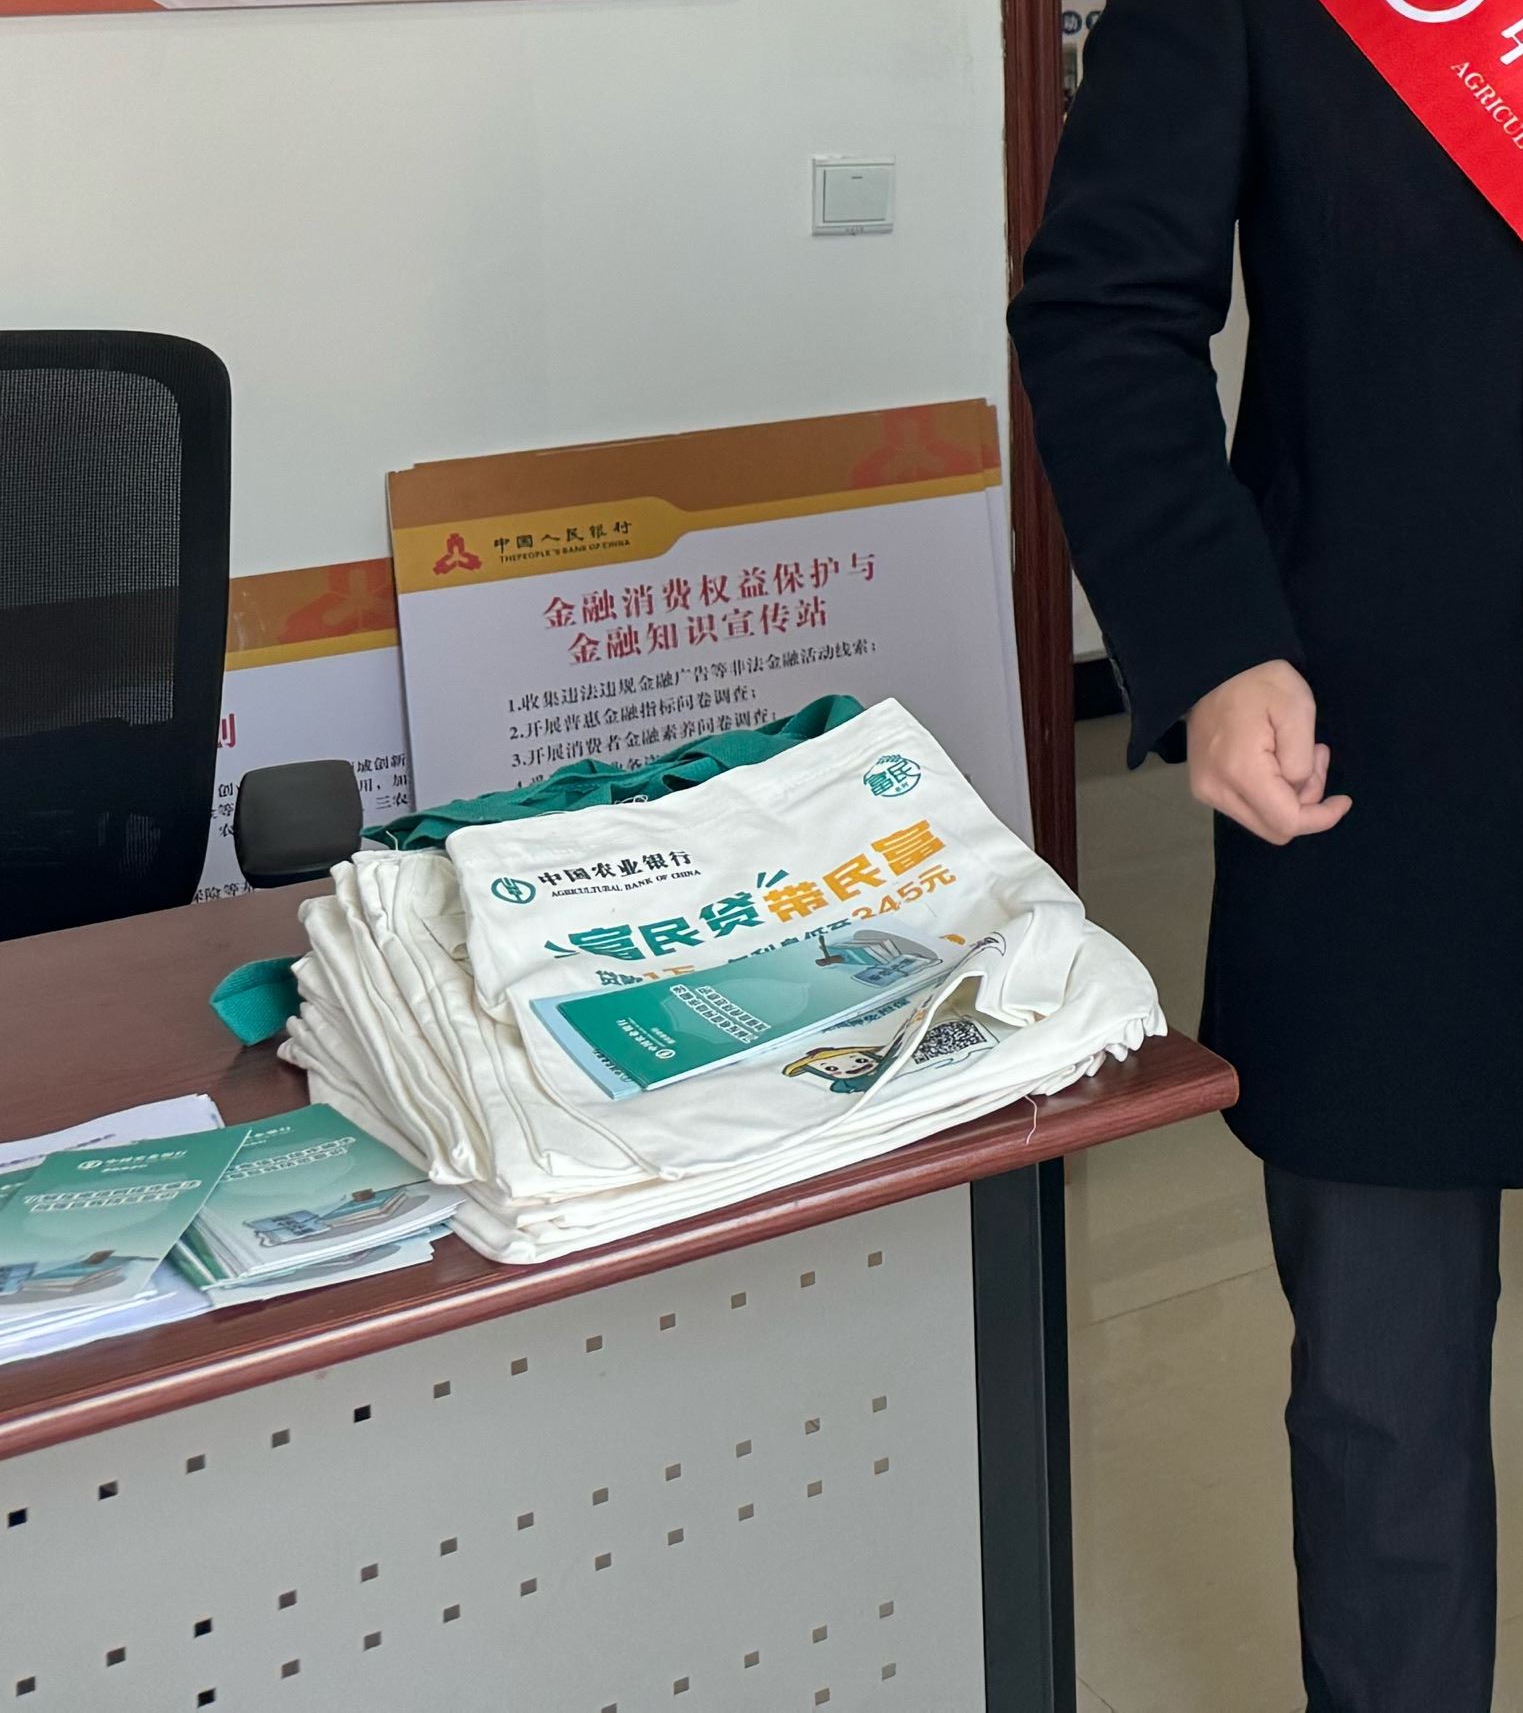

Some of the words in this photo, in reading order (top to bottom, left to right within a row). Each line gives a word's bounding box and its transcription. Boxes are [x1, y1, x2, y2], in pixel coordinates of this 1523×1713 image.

[543, 553, 876, 630] 金融消费权益保护与
[567, 598, 828, 667] 金融知识宣传站
[538, 850, 691, 887] 中国农业银行
[625, 878, 653, 891] BANK
